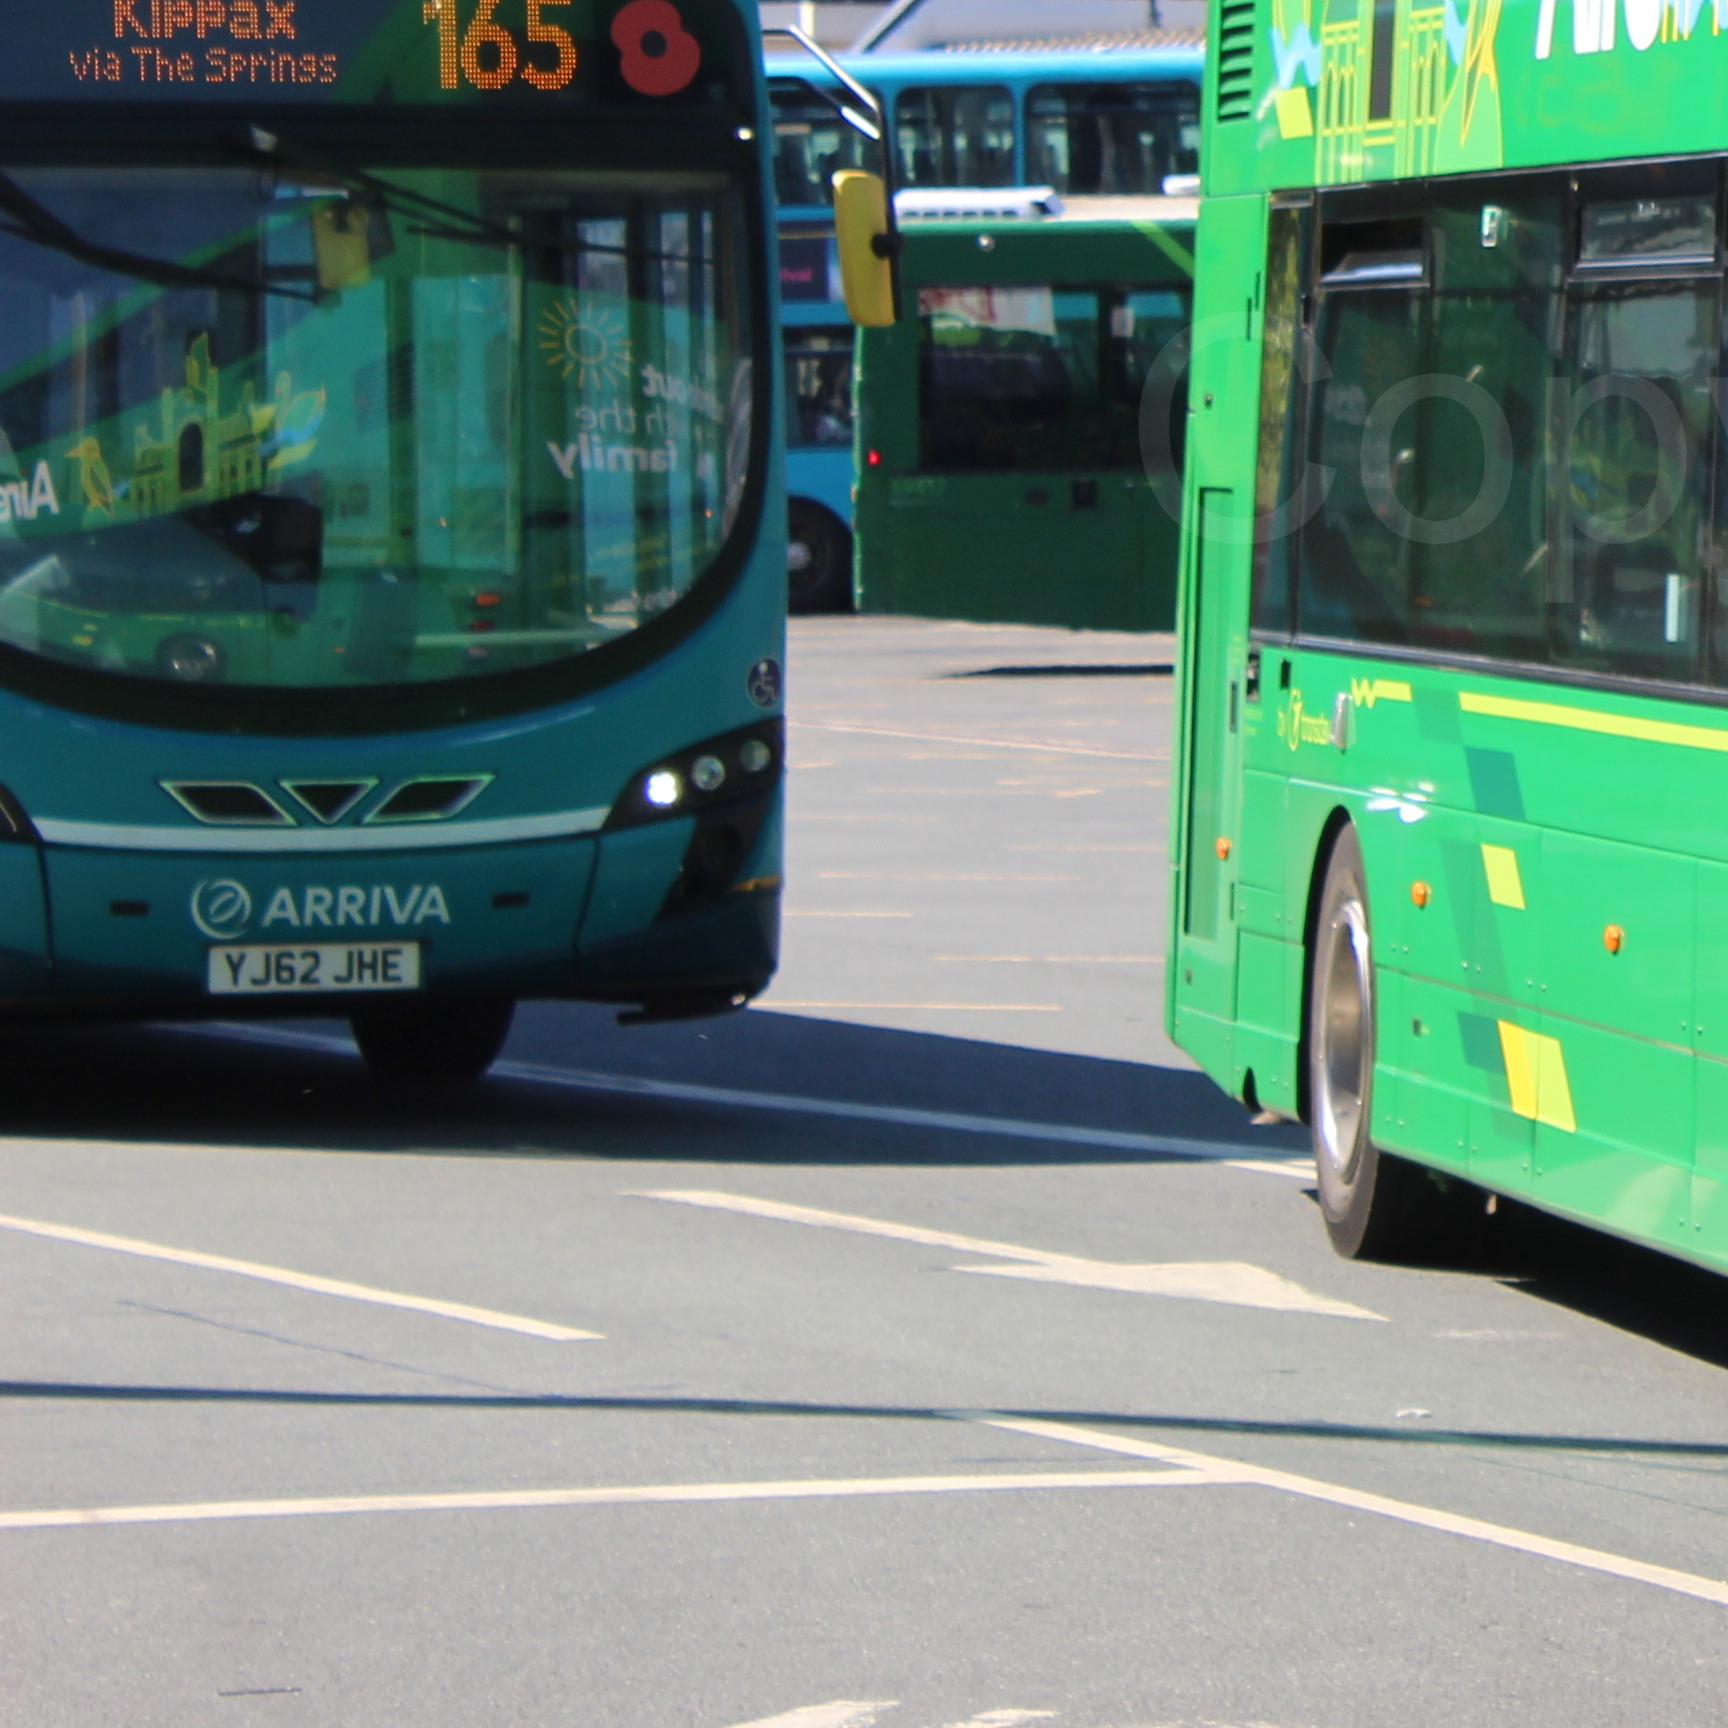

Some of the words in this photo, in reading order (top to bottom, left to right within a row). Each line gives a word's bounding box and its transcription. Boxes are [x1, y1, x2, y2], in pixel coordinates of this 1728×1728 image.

[68, 50, 121, 83] via
[132, 46, 195, 83] The
[206, 48, 338, 85] Springs
[261, 885, 450, 928] ARRIVA
[222, 949, 320, 987] YJ62
[332, 950, 403, 985] JHE
